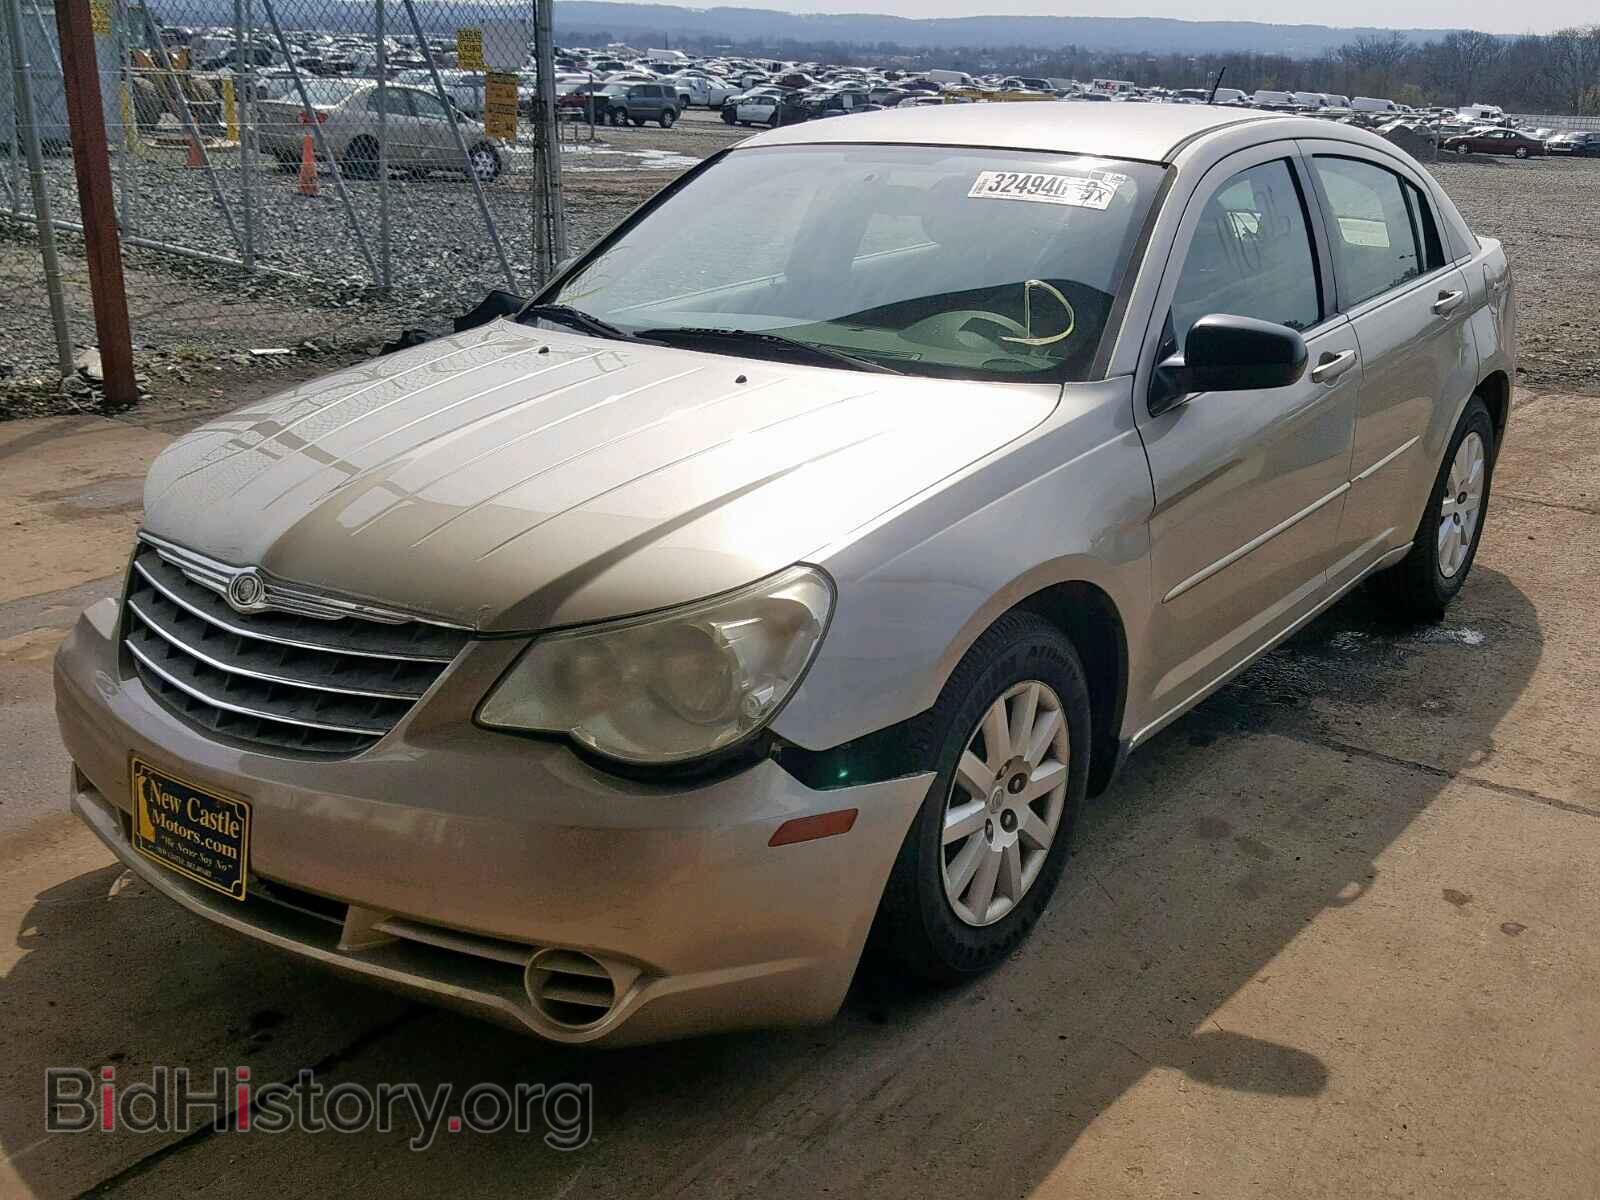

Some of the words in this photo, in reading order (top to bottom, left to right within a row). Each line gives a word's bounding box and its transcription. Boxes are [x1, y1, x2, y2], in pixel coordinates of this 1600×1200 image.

[150, 779, 181, 814] New
[187, 797, 239, 838] Castle
[153, 809, 237, 859] Motors.com
